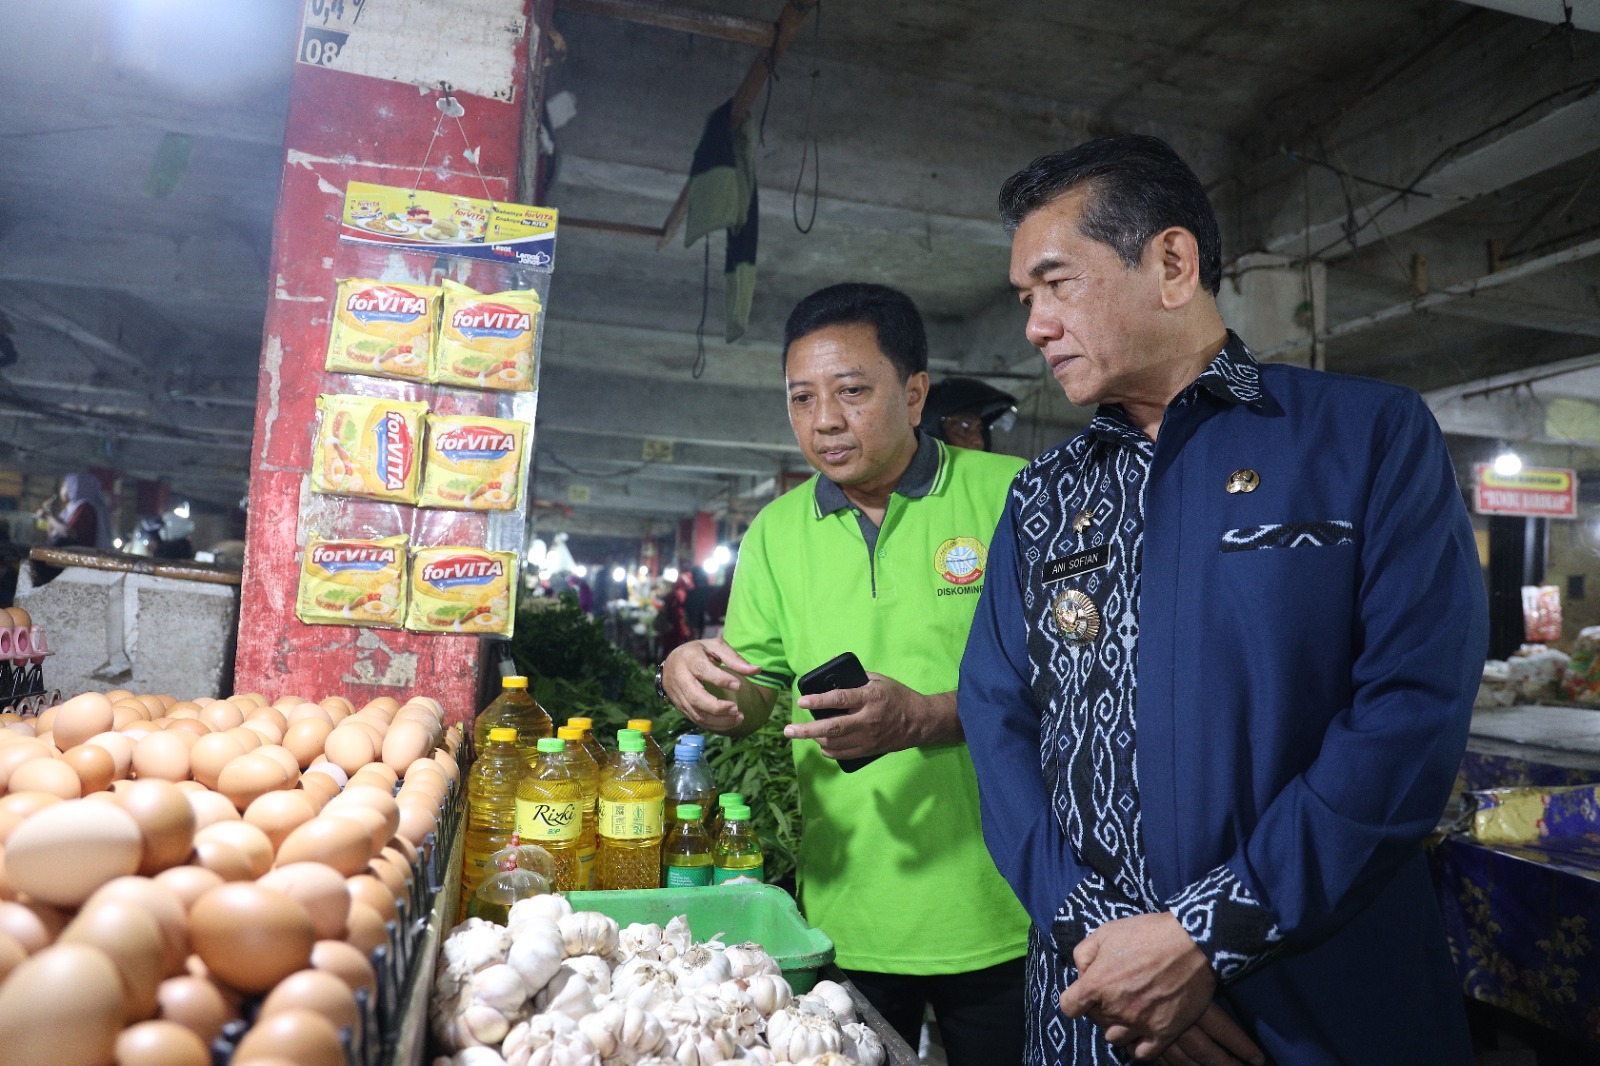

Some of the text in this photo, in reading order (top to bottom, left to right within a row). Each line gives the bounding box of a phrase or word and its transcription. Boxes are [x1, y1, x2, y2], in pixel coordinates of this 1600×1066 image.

[524, 210, 553, 221] forVITA
[516, 251, 540, 261] Lemak
[347, 294, 426, 314] forVITA
[453, 311, 530, 329] forVITA
[386, 412, 404, 490] forVITA
[437, 433, 514, 451] forVITA
[313, 547, 395, 563] forVITA
[1051, 553, 1099, 575] ANI SOFIAN
[423, 561, 503, 580] forVITA
[532, 803, 576, 827] Rizki
